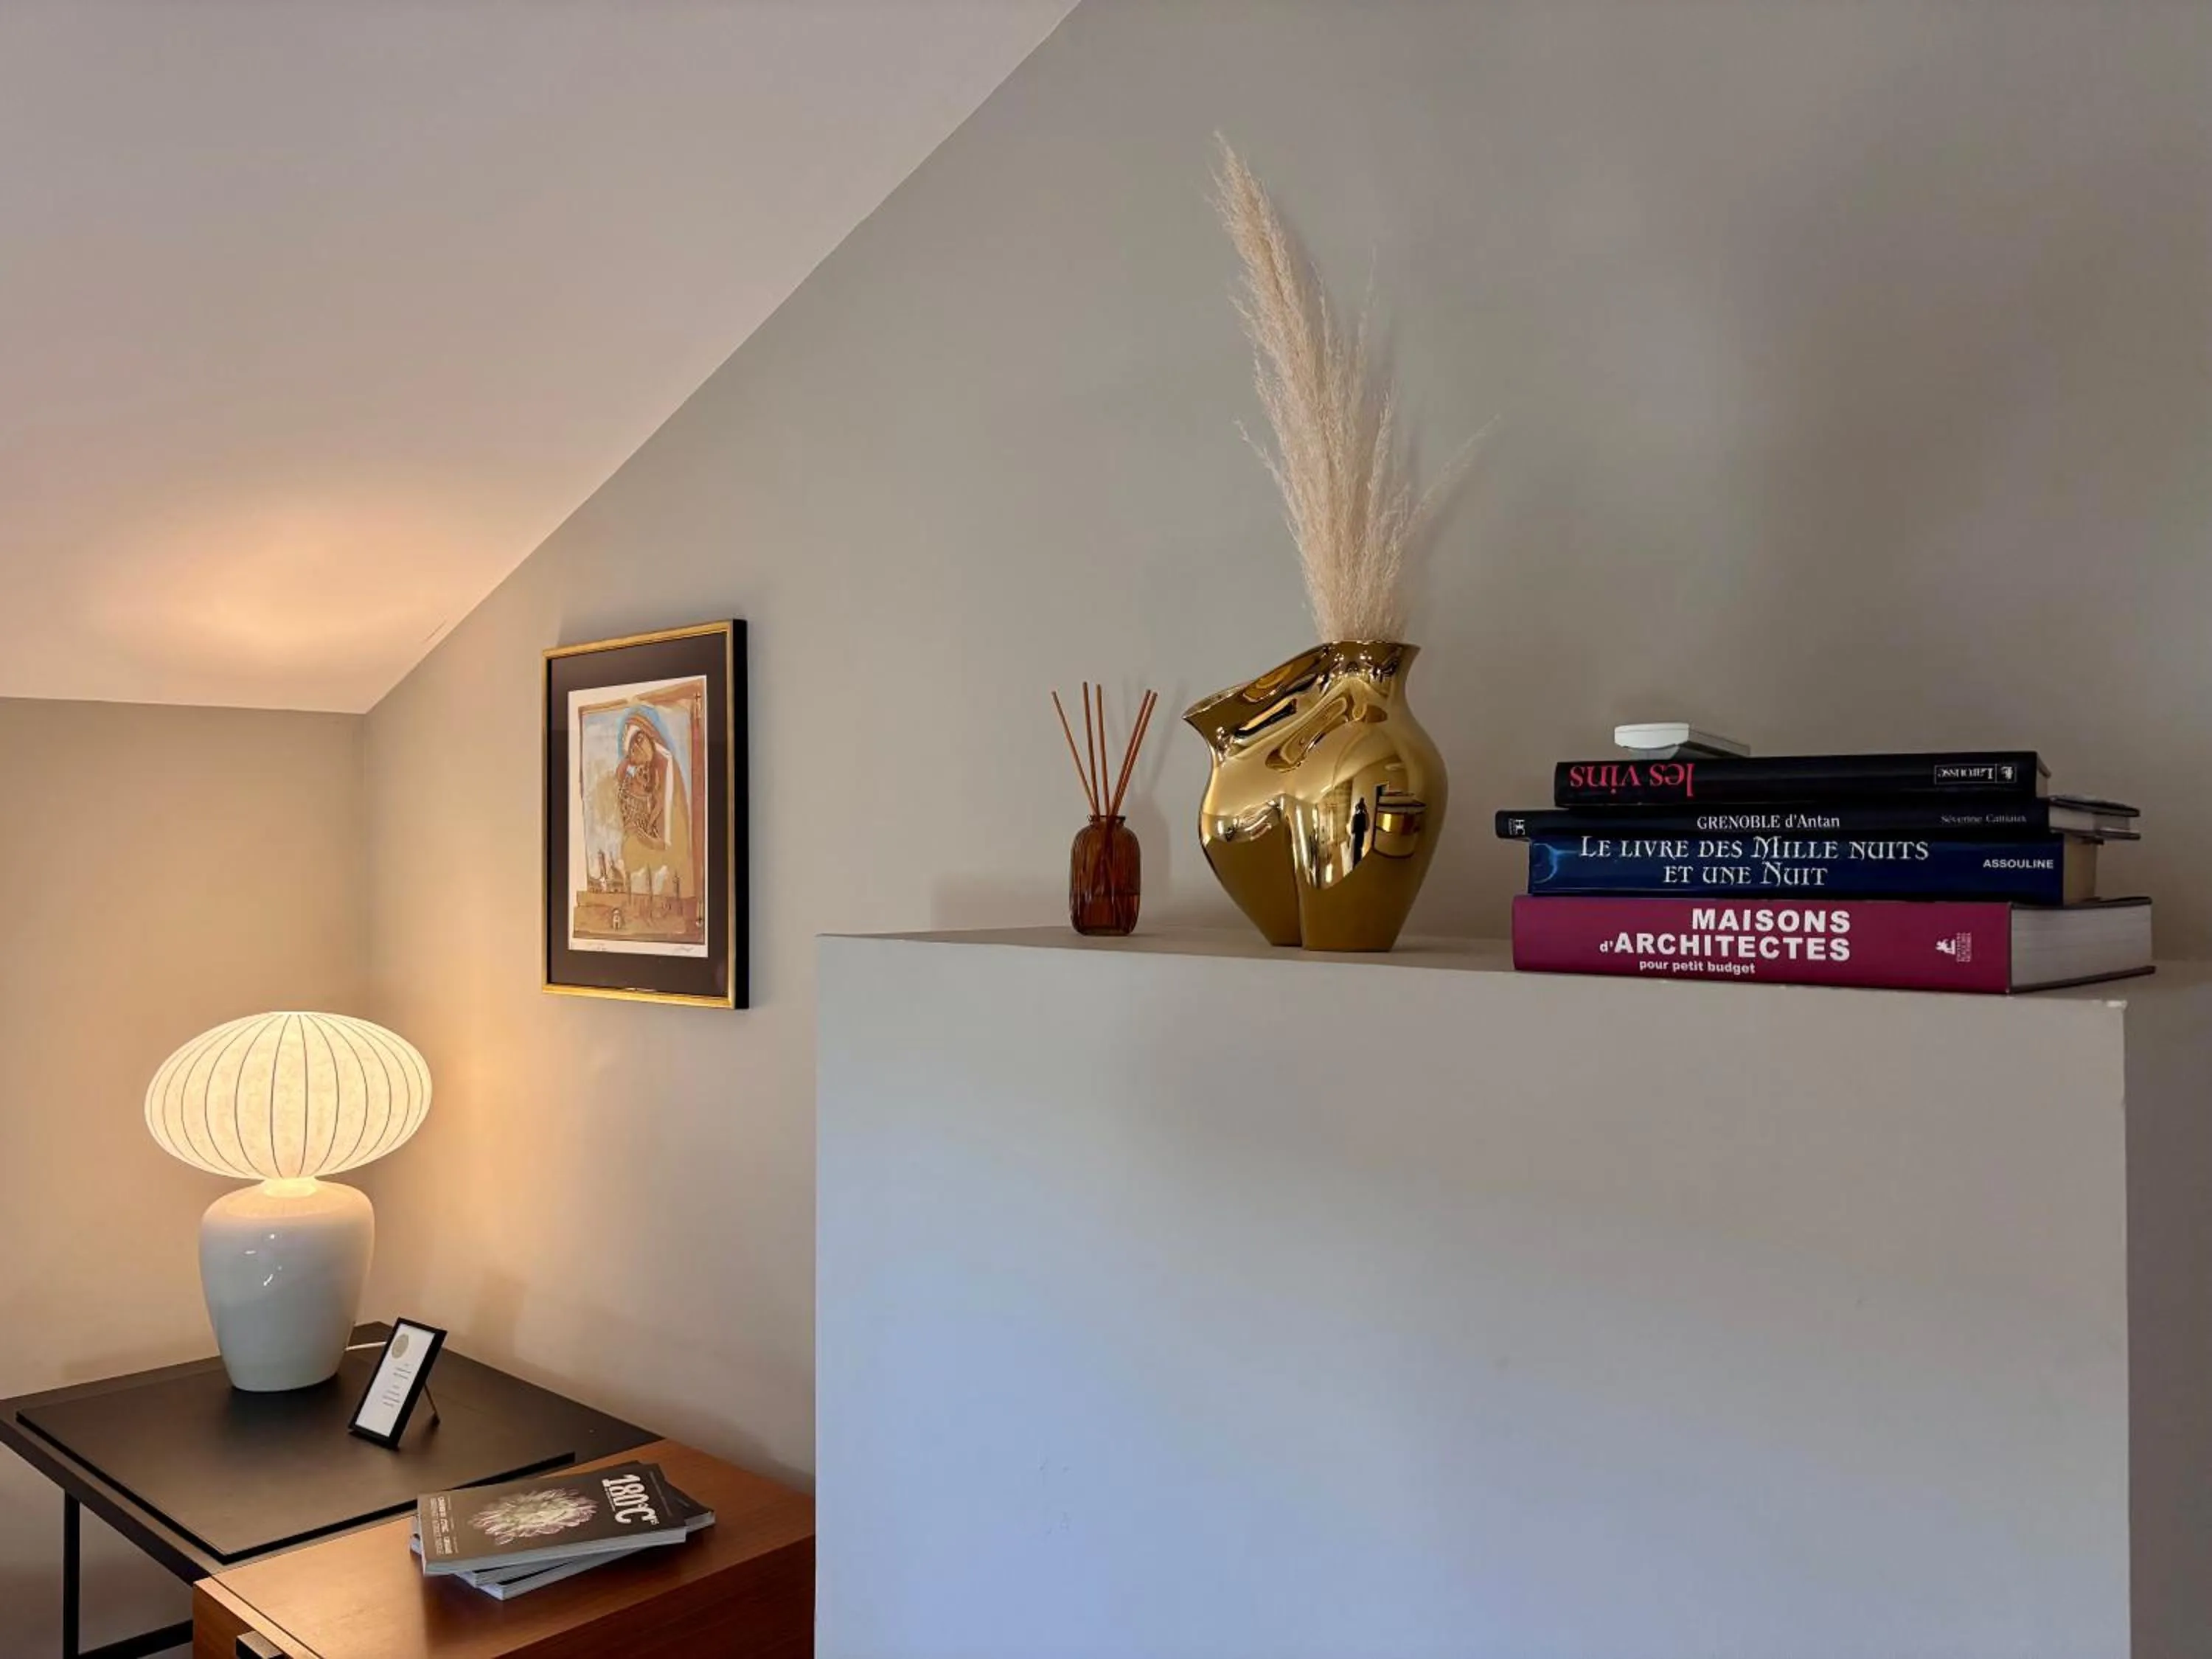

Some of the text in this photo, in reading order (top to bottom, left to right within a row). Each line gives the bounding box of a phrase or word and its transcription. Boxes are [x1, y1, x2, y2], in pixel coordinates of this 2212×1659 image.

[1570, 763, 1694, 797] les vins
[1697, 814, 1840, 830] GRENOBLE d'Antan
[1983, 858, 2054, 869] ASSOULINE
[1691, 908, 1851, 933] MAISONS
[1599, 932, 1851, 961] d'ARCHITECTES
[1638, 960, 1756, 975] pour petit budget
